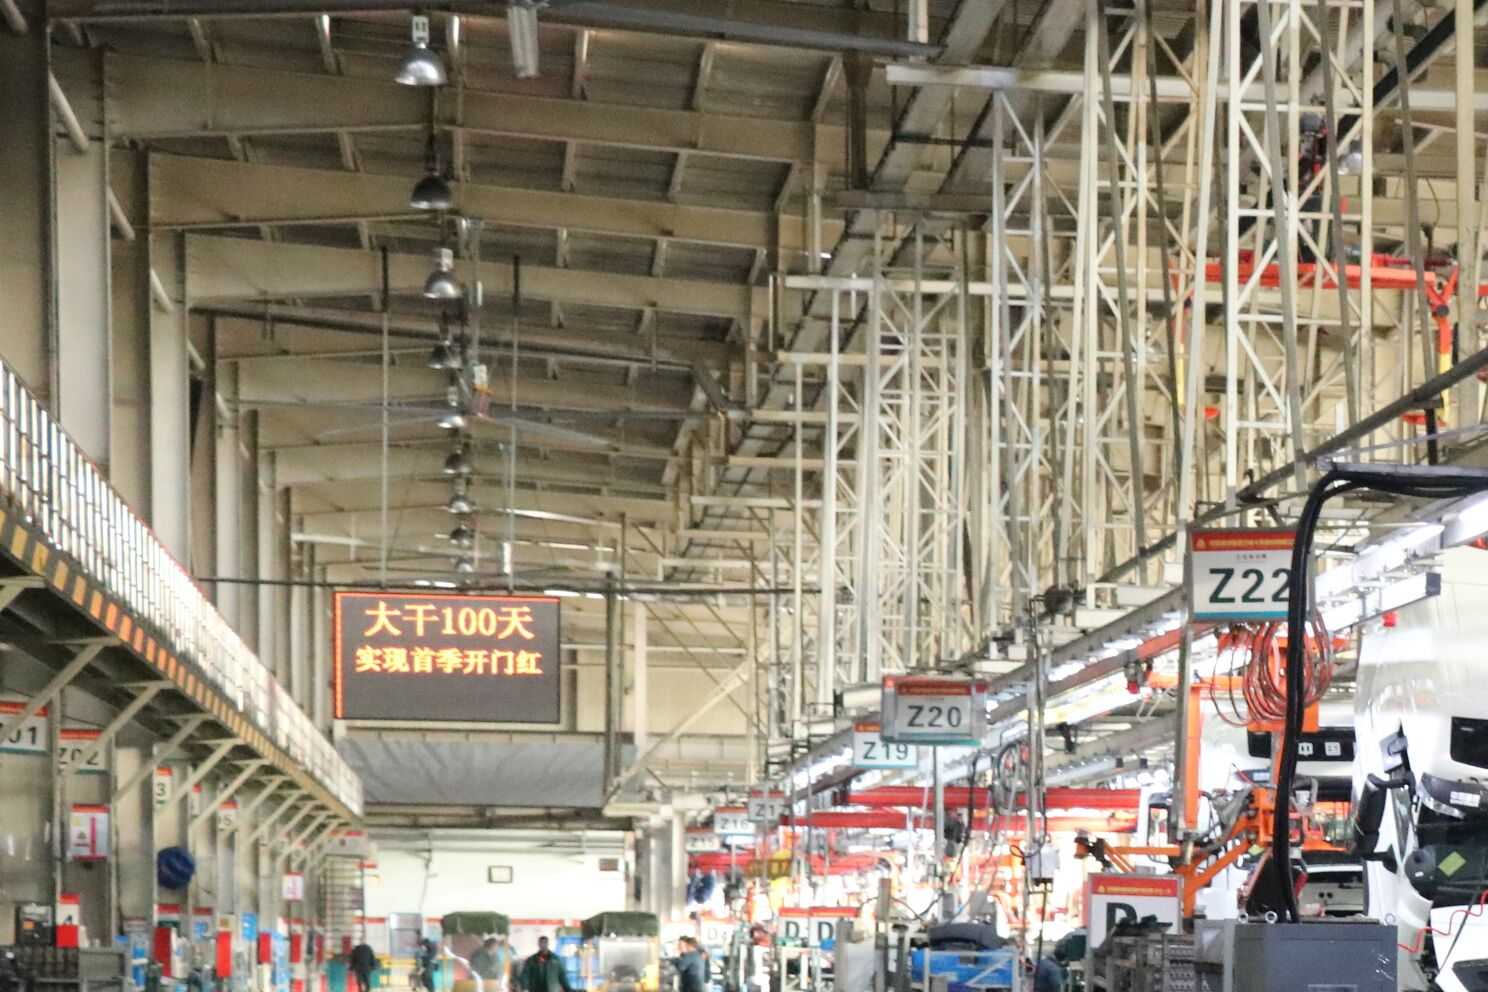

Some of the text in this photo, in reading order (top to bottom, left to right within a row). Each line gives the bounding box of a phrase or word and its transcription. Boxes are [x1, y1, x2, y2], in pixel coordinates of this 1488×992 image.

[1209, 568, 1291, 603] Z22
[364, 600, 535, 640] 大干100天
[355, 645, 544, 675] 实现首季开门红
[907, 705, 962, 728] Z20
[863, 741, 909, 760] Z19
